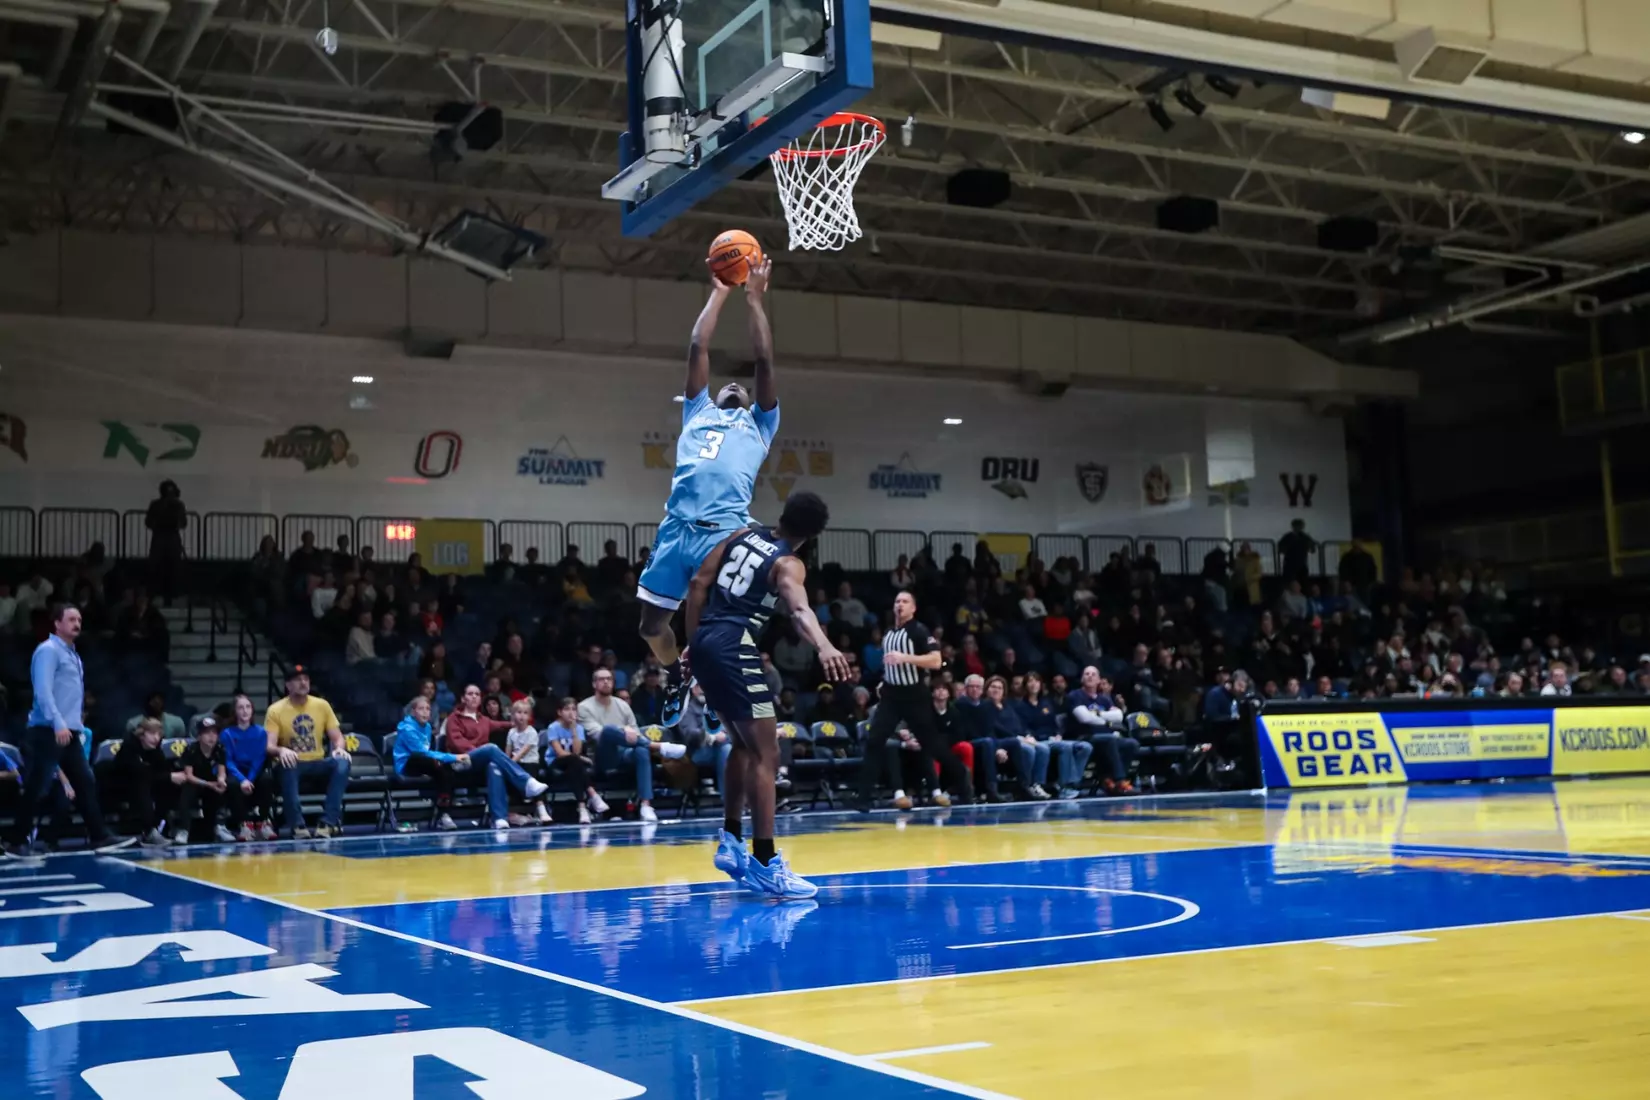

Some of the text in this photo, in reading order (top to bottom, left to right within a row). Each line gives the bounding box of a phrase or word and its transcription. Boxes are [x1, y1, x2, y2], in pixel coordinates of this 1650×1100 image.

[698, 430, 725, 460] 3
[517, 457, 605, 477] SUMMIT
[982, 457, 1039, 482] ORU
[538, 477, 588, 486] LEAGUE
[869, 471, 942, 490] SUMMIT
[1280, 471, 1318, 507] W
[431, 542, 469, 566] 106
[717, 543, 765, 597] 25
[1282, 729, 1377, 752] ROOS
[1559, 727, 1650, 753] KCROOS.COM
[1297, 753, 1394, 777] GEAR
